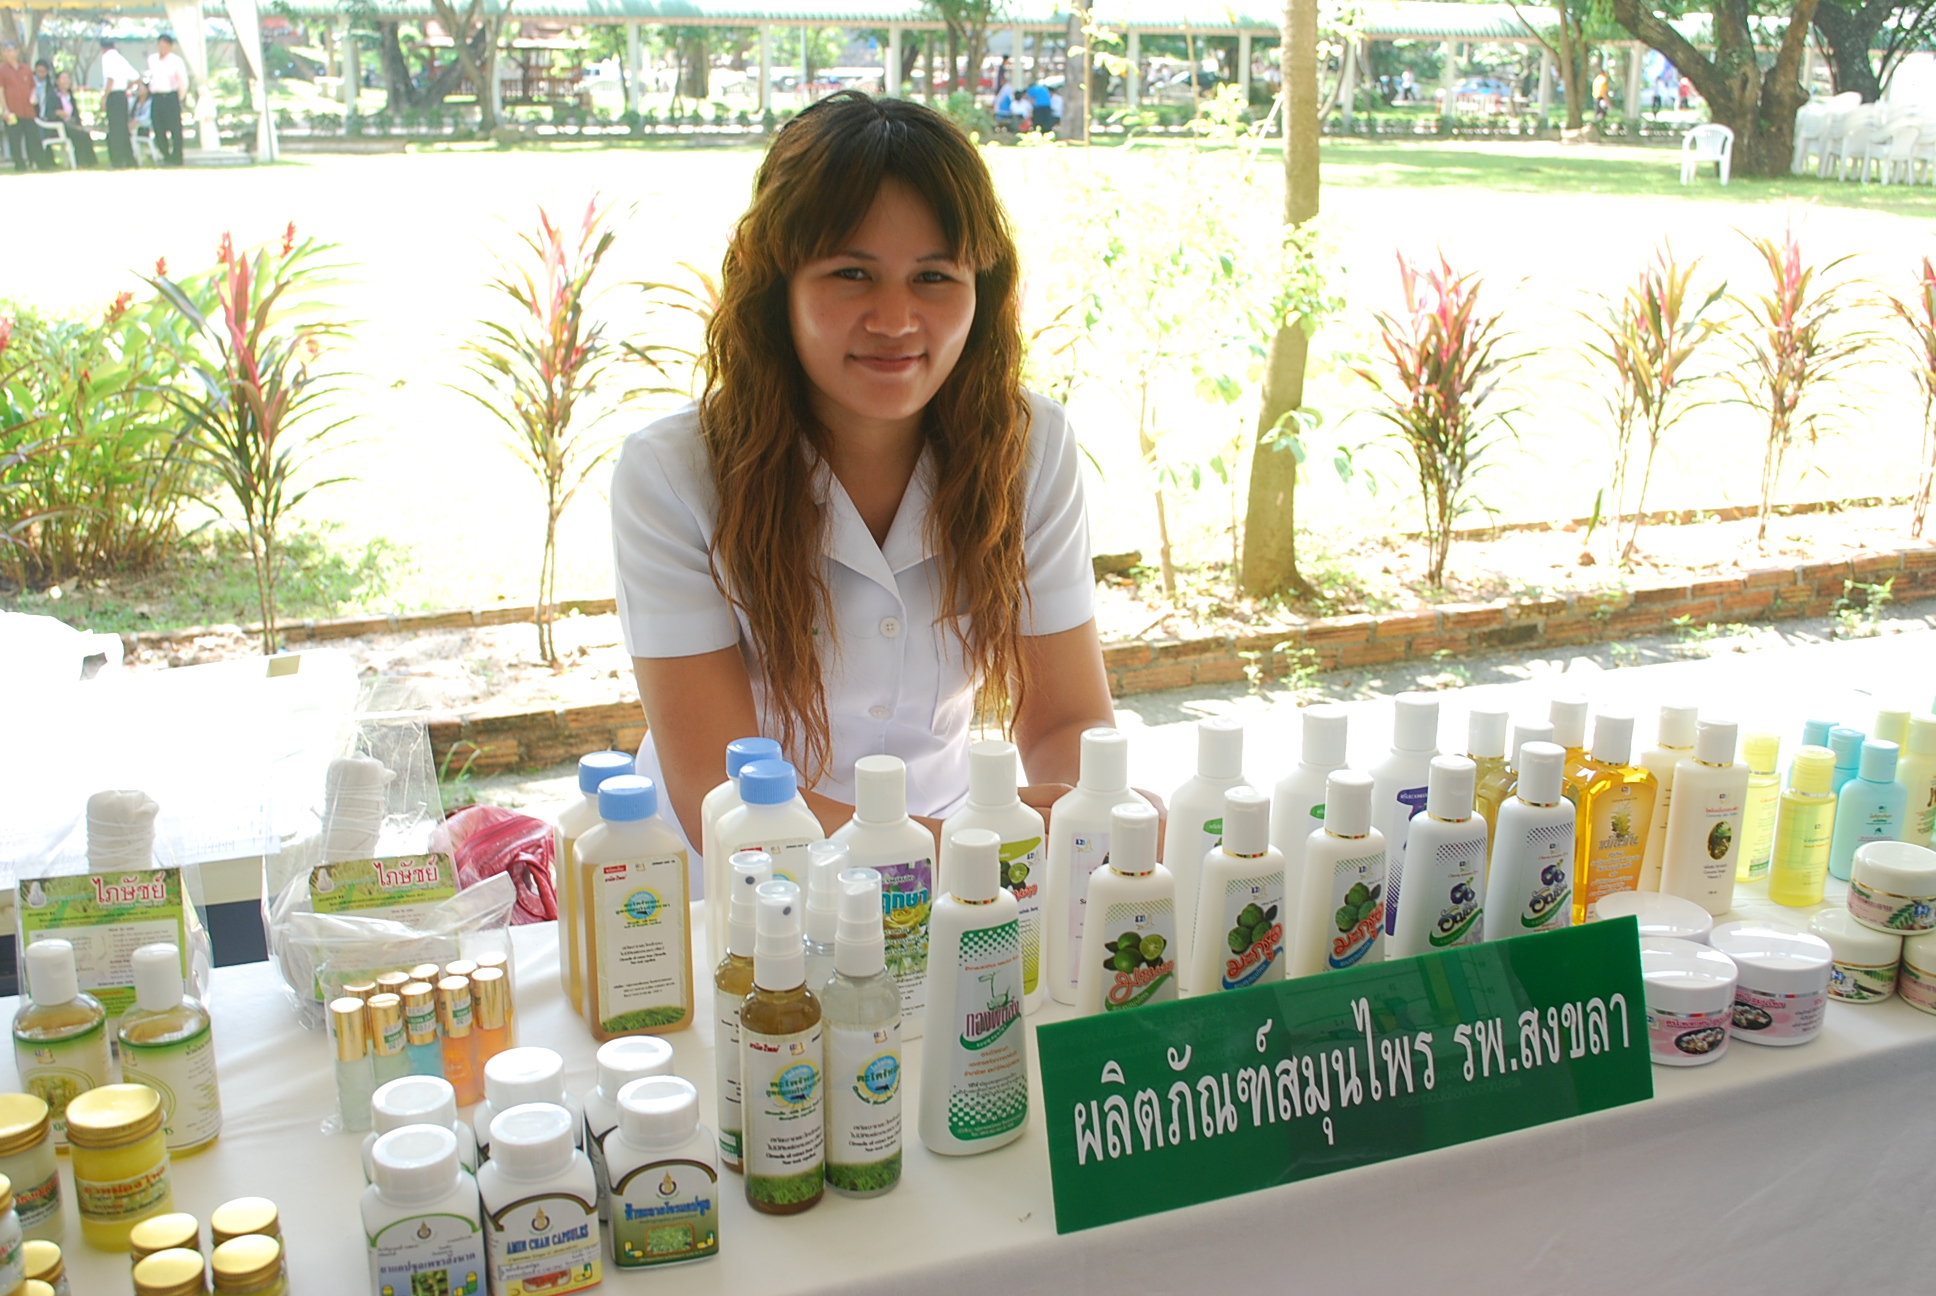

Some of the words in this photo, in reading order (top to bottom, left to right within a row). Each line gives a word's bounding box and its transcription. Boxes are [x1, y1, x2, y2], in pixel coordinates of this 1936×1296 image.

[92, 872, 165, 903] ไภษัชย์
[374, 856, 438, 886] ไภษัชย์
[1226, 923, 1283, 979] มะกรูด
[1074, 996, 1435, 1166] ผลิตภัณฑ์สมุนไพร
[1453, 992, 1630, 1082] รพ.สงขลา
